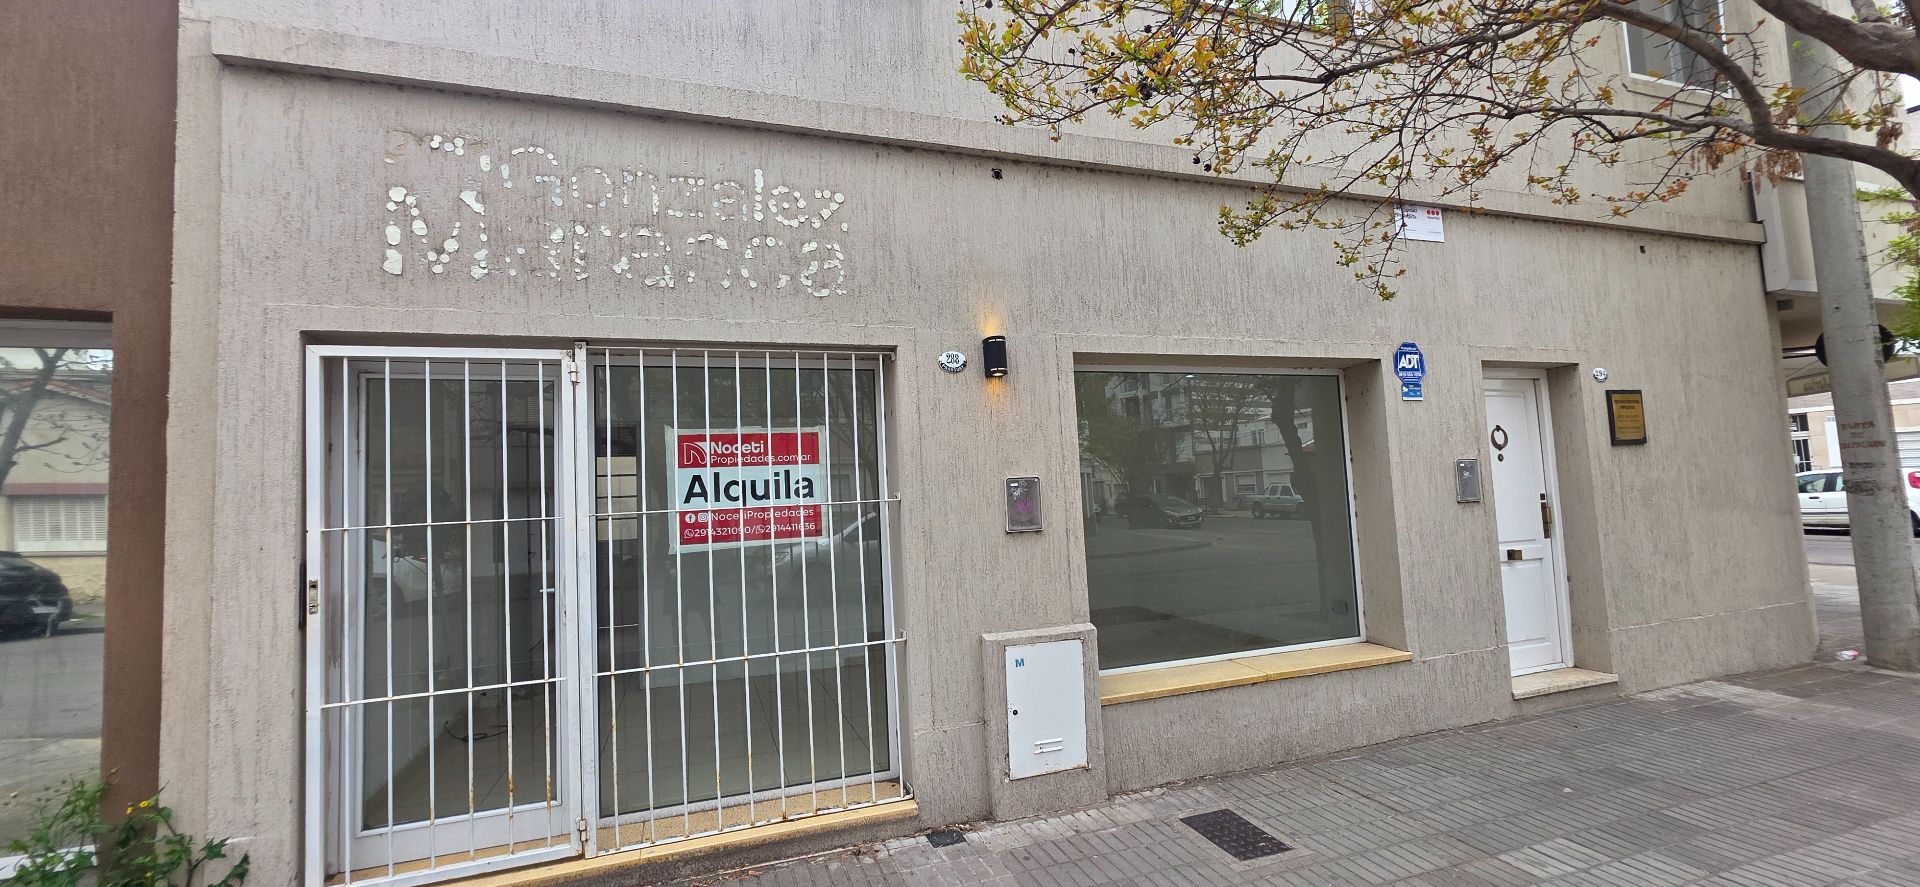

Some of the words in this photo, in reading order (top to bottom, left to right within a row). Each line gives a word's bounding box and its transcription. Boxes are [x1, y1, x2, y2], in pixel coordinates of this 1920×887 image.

[945, 353, 960, 364] 288
[1398, 354, 1419, 369] ADT
[711, 441, 764, 453] Noceti
[711, 454, 811, 465] Propiedades.comar
[683, 469, 814, 506] Alquila
[711, 508, 814, 521] NoceiPropedades
[1015, 658, 1024, 667] M
